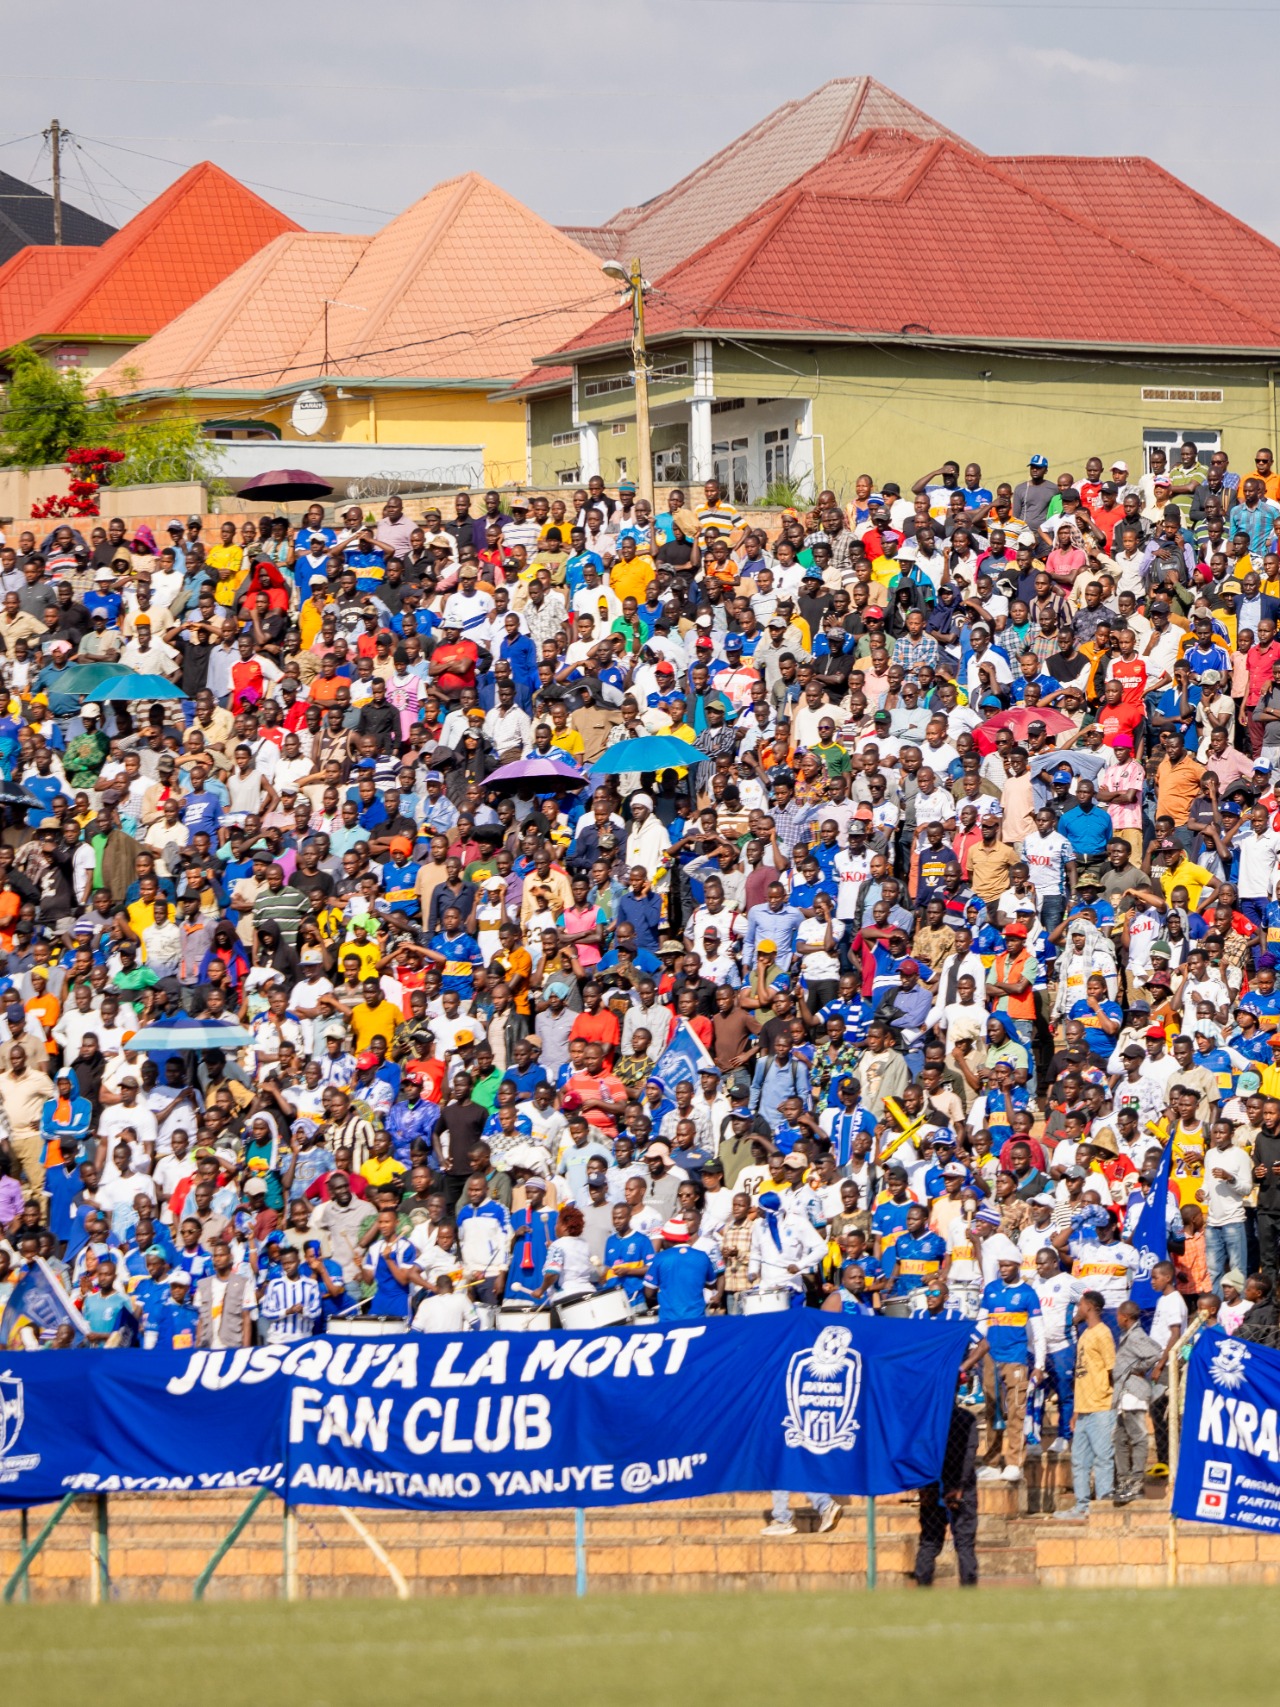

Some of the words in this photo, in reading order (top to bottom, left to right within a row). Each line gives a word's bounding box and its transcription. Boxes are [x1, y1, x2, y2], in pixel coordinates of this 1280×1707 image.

[1027, 854, 1053, 868] SKOL
[743, 1175, 765, 1196] 62
[166, 1340, 420, 1395] JUSQU'A
[430, 1340, 510, 1388] LA
[520, 1326, 707, 1383] MORT
[289, 1386, 394, 1453] FAN
[403, 1393, 552, 1455] CLUB
[290, 1463, 482, 1498] AMAHITAMO
[486, 1464, 615, 1497] YANJYE
[1237, 1510, 1279, 1528] HEART
